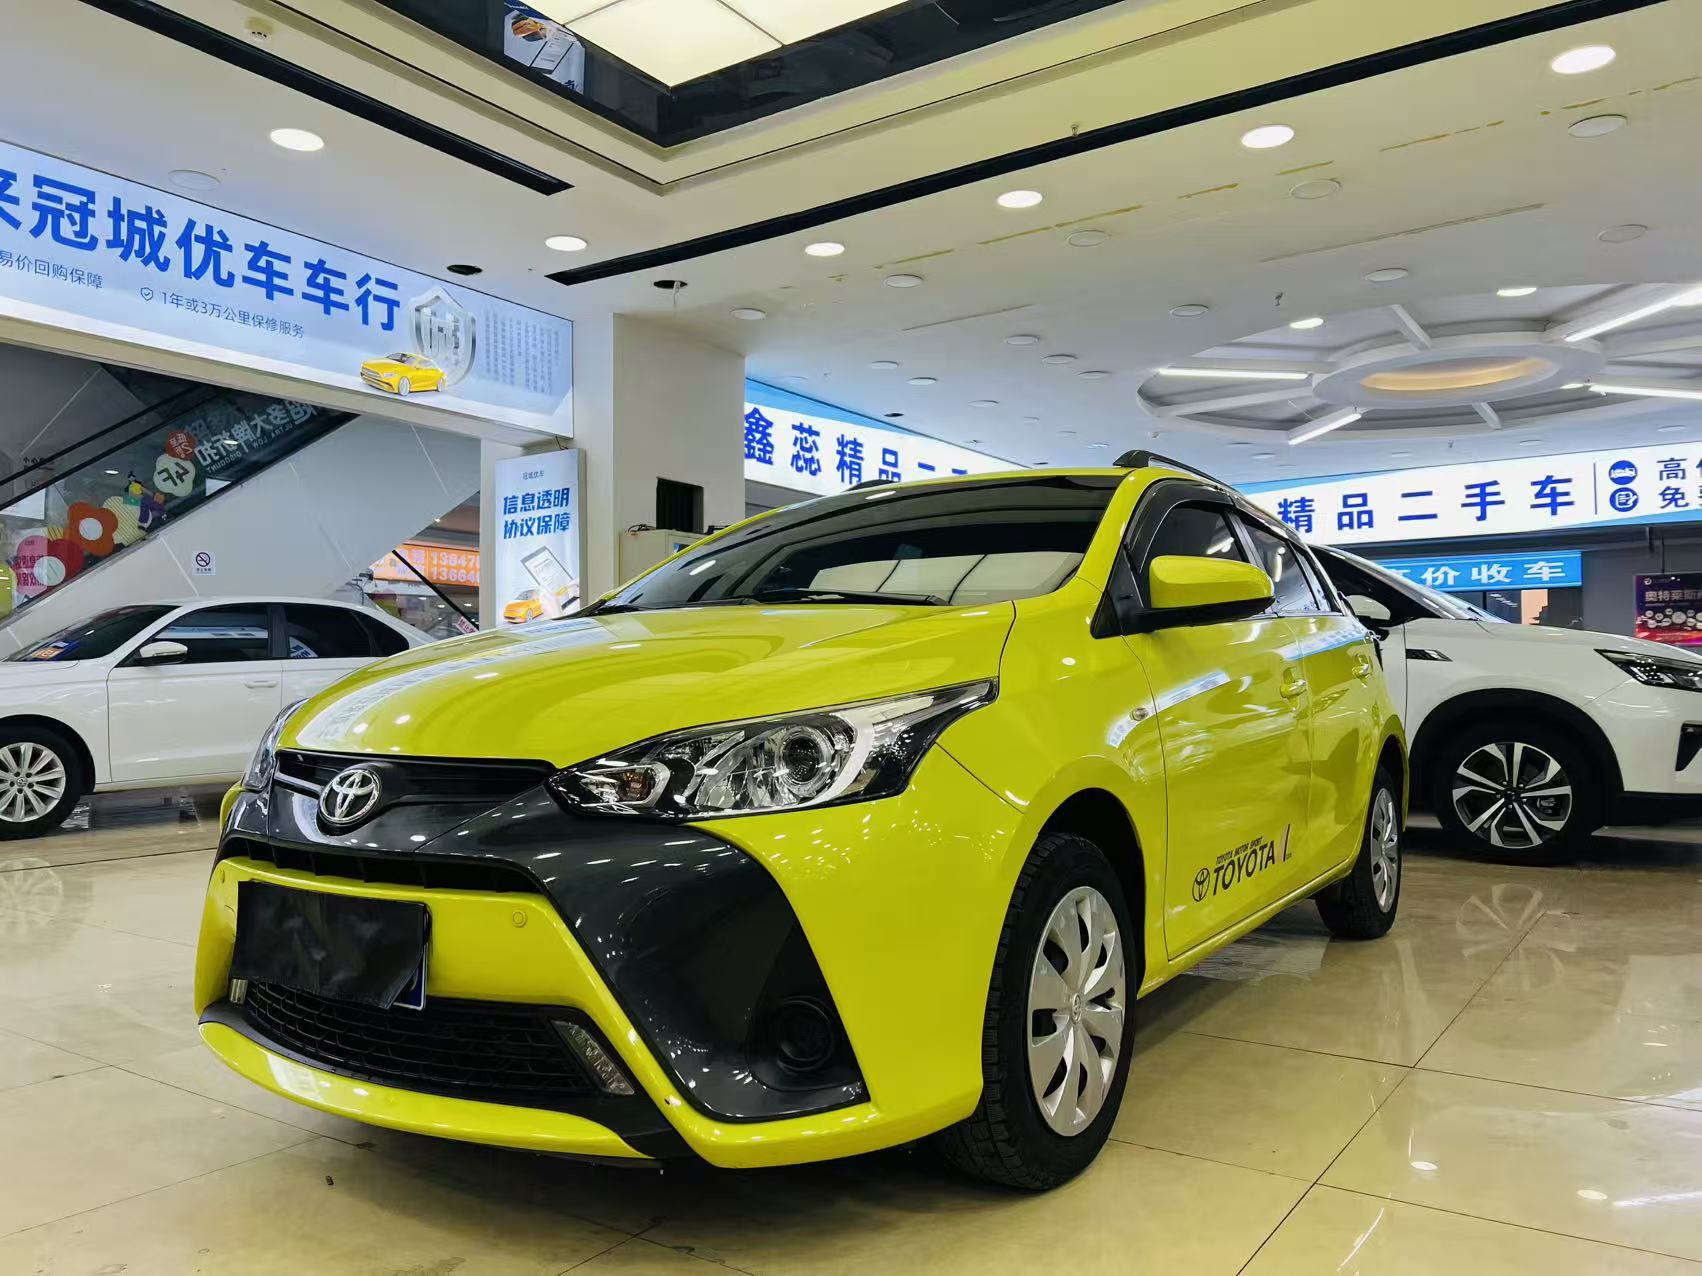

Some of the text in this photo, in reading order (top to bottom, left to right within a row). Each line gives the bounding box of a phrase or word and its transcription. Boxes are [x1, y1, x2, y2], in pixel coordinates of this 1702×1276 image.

[161, 291, 304, 339] 1年或3万公里保修服务
[1656, 457, 1702, 481] 高
[503, 487, 570, 515] 信息透明
[1277, 475, 1575, 533] 精品二手车
[1658, 485, 1702, 509] 免
[503, 512, 571, 539] 协议保障
[1389, 561, 1566, 586] 价收车
[1213, 840, 1275, 896] TOYOTA
